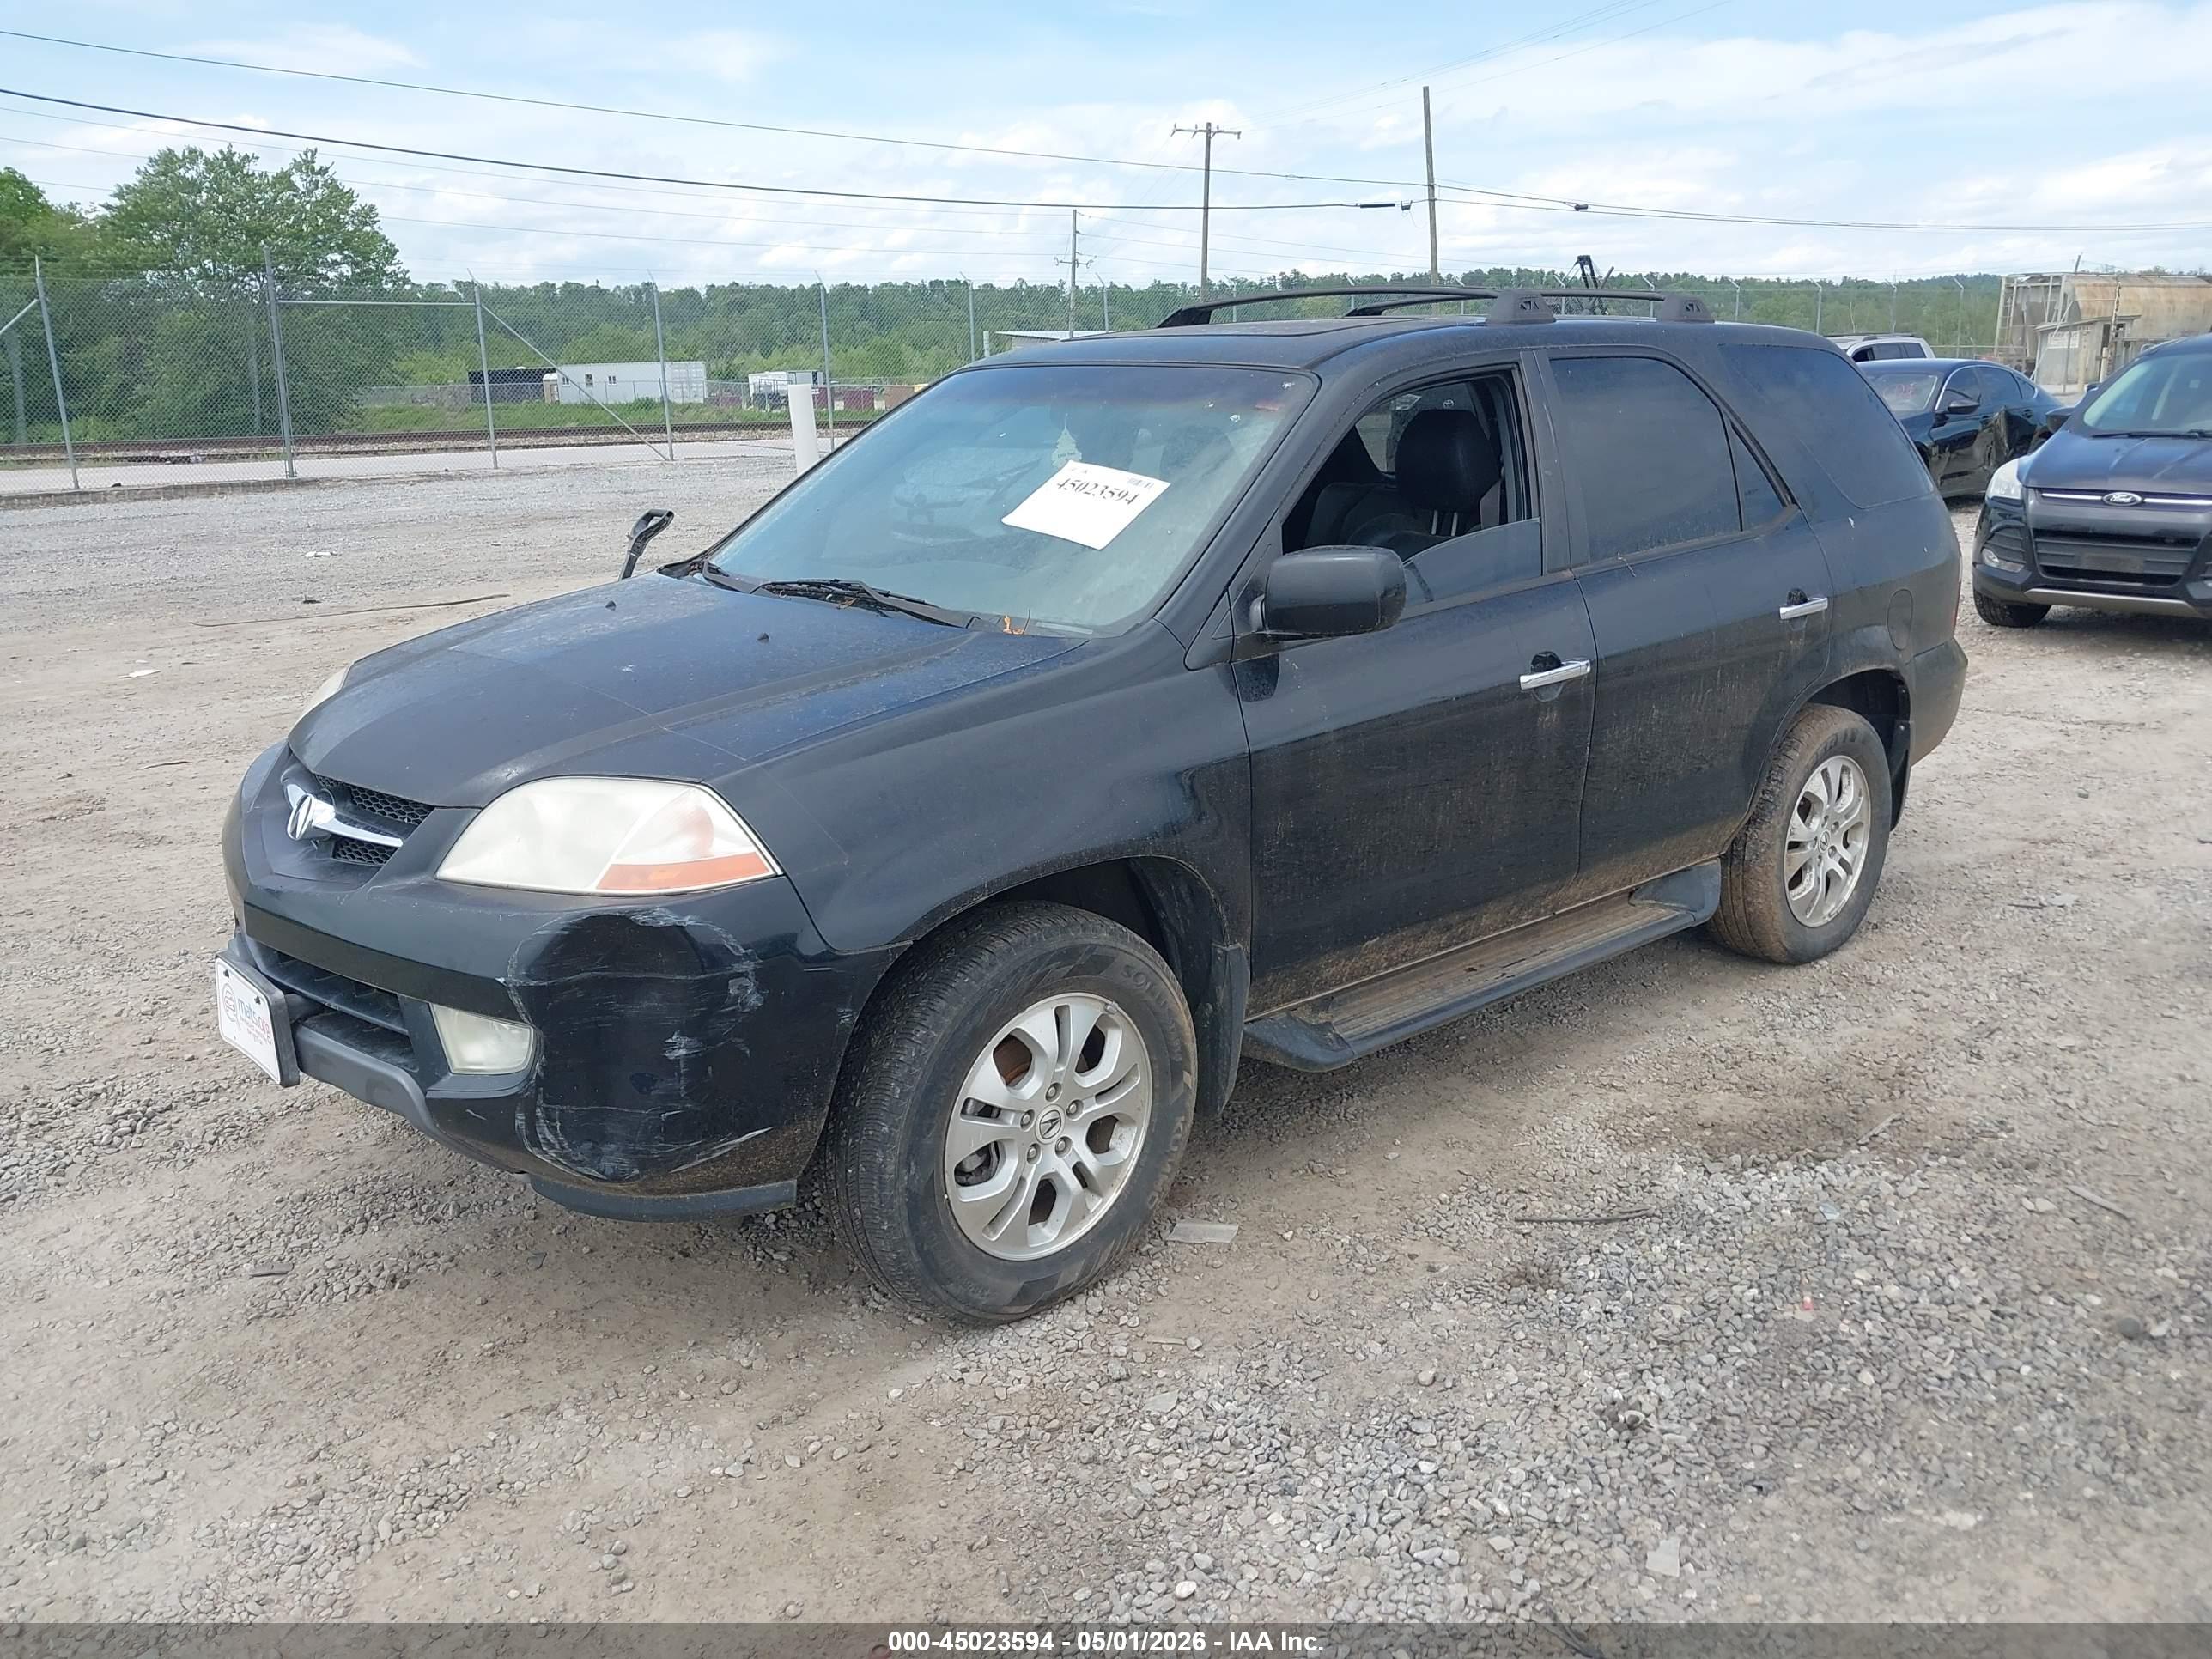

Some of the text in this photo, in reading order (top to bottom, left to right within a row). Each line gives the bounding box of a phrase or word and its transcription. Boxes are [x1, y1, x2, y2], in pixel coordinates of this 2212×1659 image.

[1057, 478, 1139, 505] 45023594
[2109, 494, 2134, 503] Ford
[237, 998, 272, 1044] mats.org
